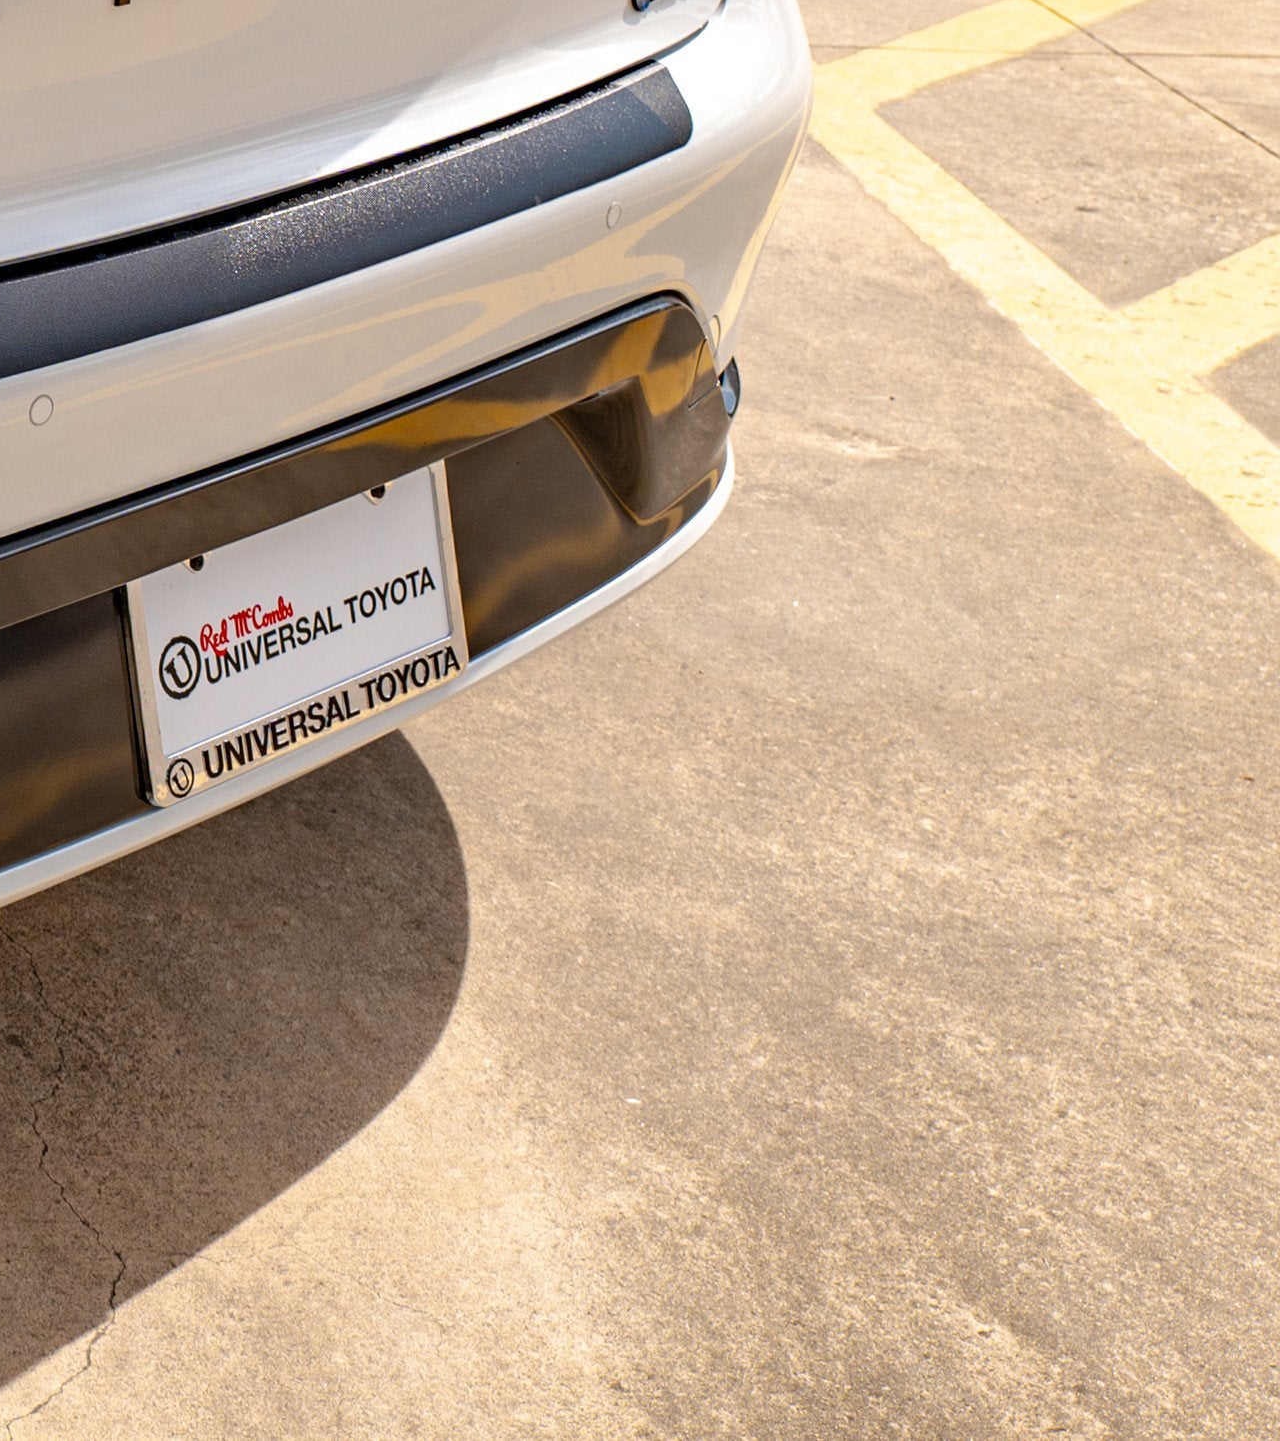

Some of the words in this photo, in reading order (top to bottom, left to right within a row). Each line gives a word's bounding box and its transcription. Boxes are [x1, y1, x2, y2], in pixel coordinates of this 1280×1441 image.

[200, 618, 230, 656] Red
[229, 595, 294, 639] McCombs
[204, 605, 343, 684] UNIVERSAL
[343, 566, 436, 625] TOYOTA
[201, 689, 361, 779] UNIVERSAL
[358, 645, 461, 709] TOYOTA
